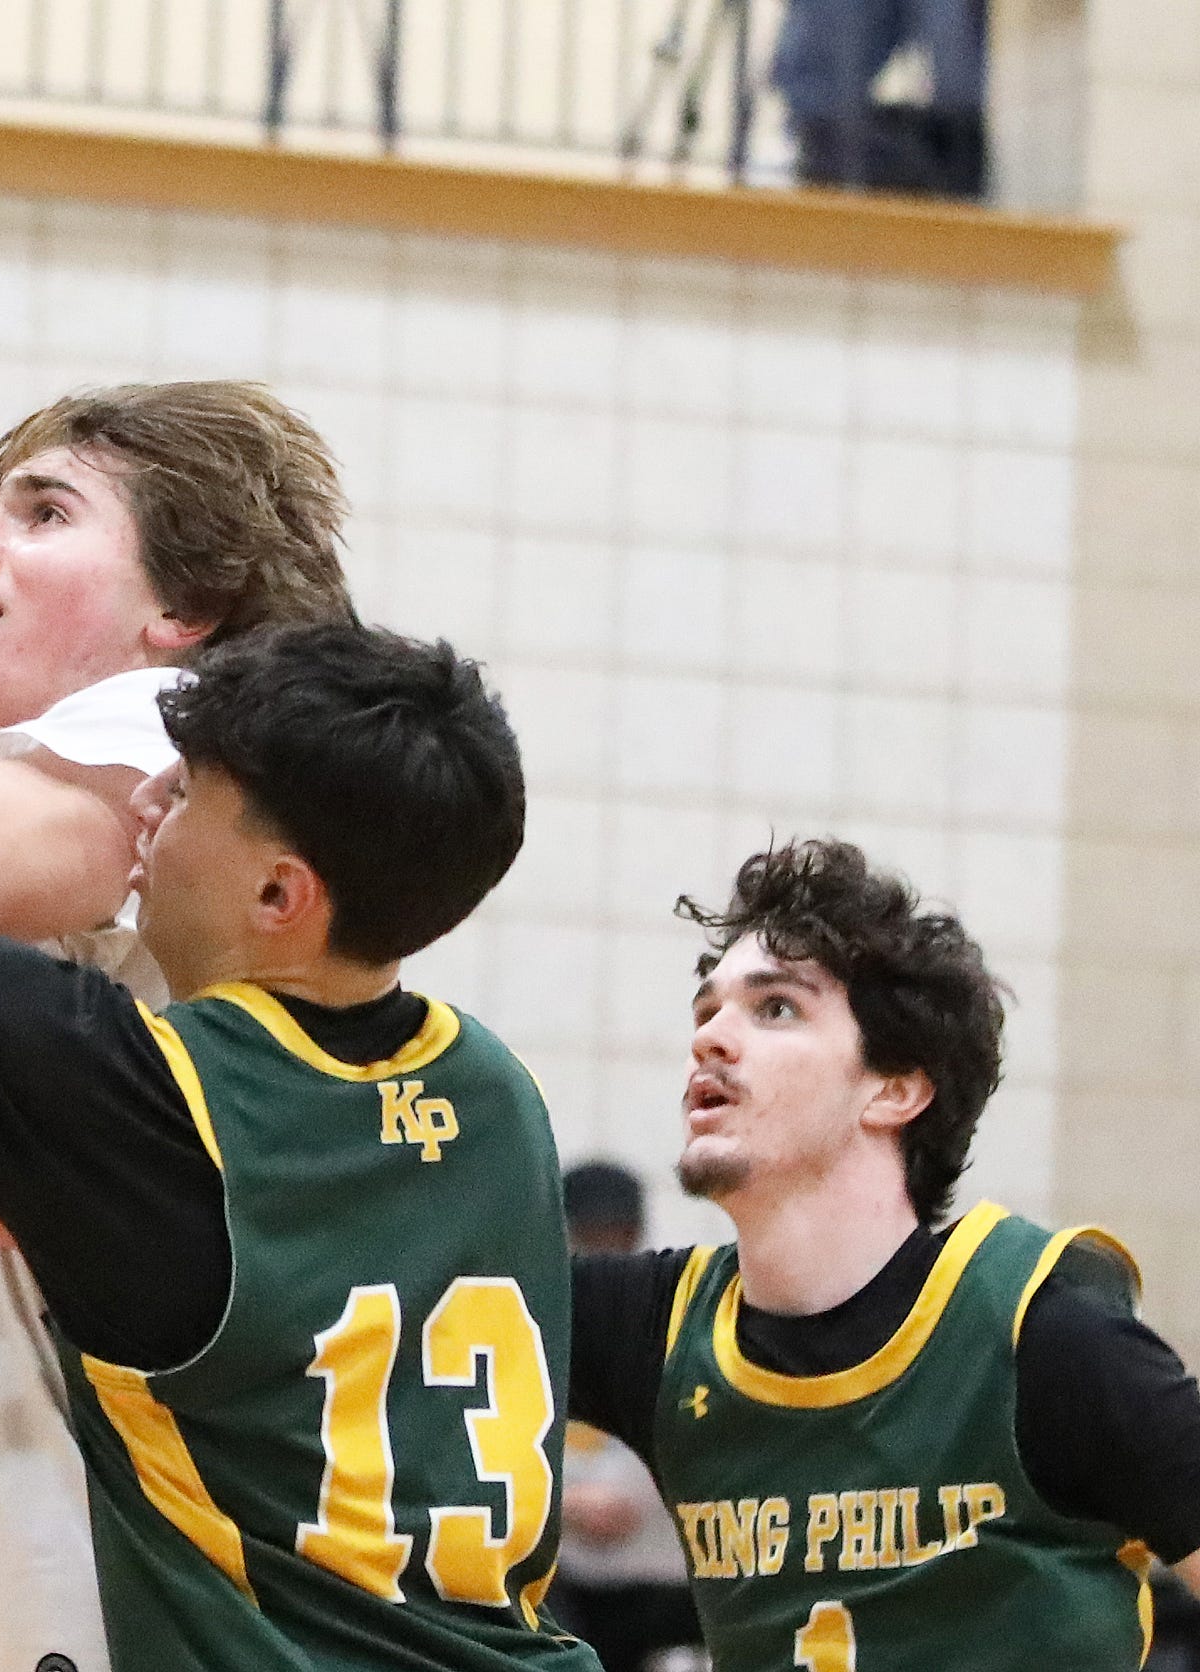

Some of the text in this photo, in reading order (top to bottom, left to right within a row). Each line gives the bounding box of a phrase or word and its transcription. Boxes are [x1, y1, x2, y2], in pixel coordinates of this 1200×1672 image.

[377, 1080, 460, 1162] KP
[296, 1276, 555, 1607] 13
[804, 1482, 1006, 1574] PHILIP
